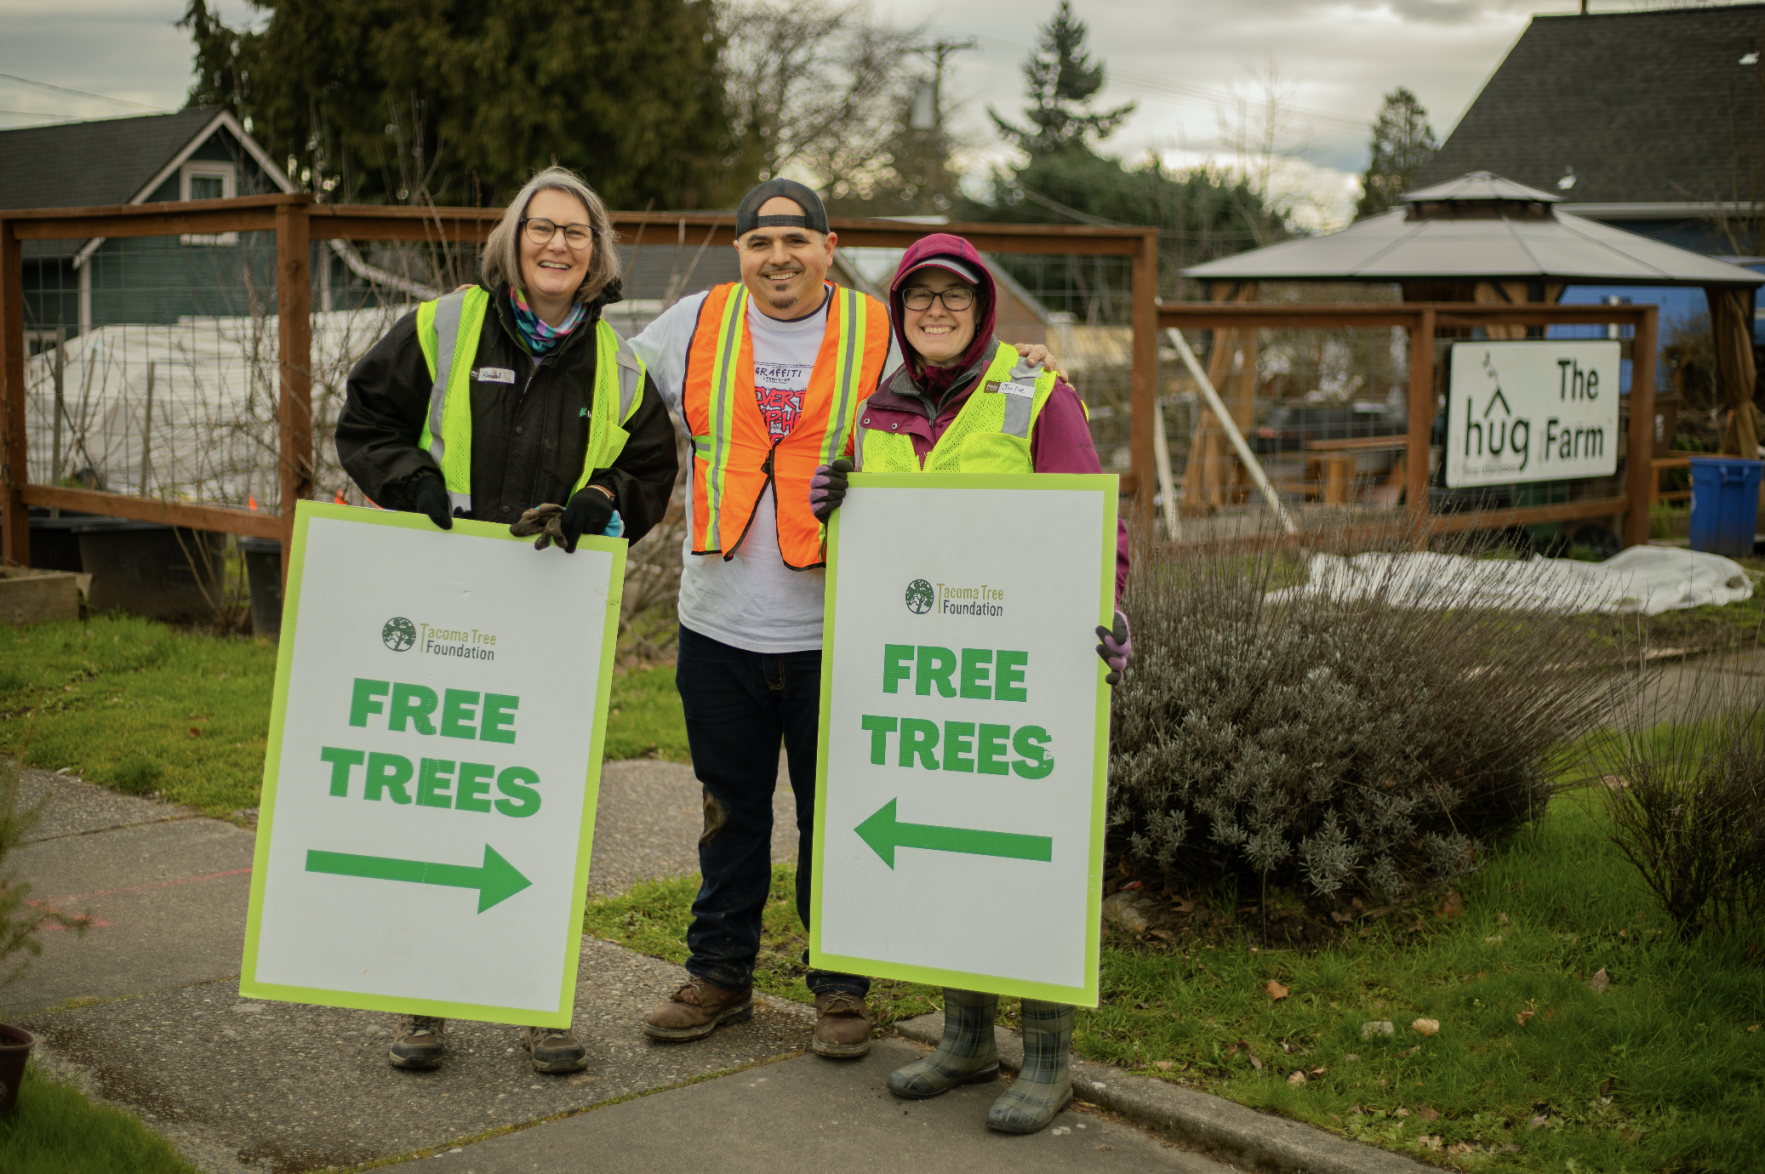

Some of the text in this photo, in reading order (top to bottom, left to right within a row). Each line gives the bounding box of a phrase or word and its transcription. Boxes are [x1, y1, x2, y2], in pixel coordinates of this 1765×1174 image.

[755, 367, 802, 378] GRAFFITI
[1557, 358, 1599, 400] The
[1465, 395, 1530, 472] hug
[1545, 418, 1604, 461] Farm
[936, 583, 1004, 614] Tacoma Tree
[943, 599, 1003, 617] Foundation
[419, 623, 497, 653] Tacoma Tree
[426, 639, 495, 661] Foundation
[883, 643, 1029, 703] FREE
[349, 677, 520, 745] FREE
[861, 714, 1055, 780] TREES
[320, 746, 542, 818] TREES
